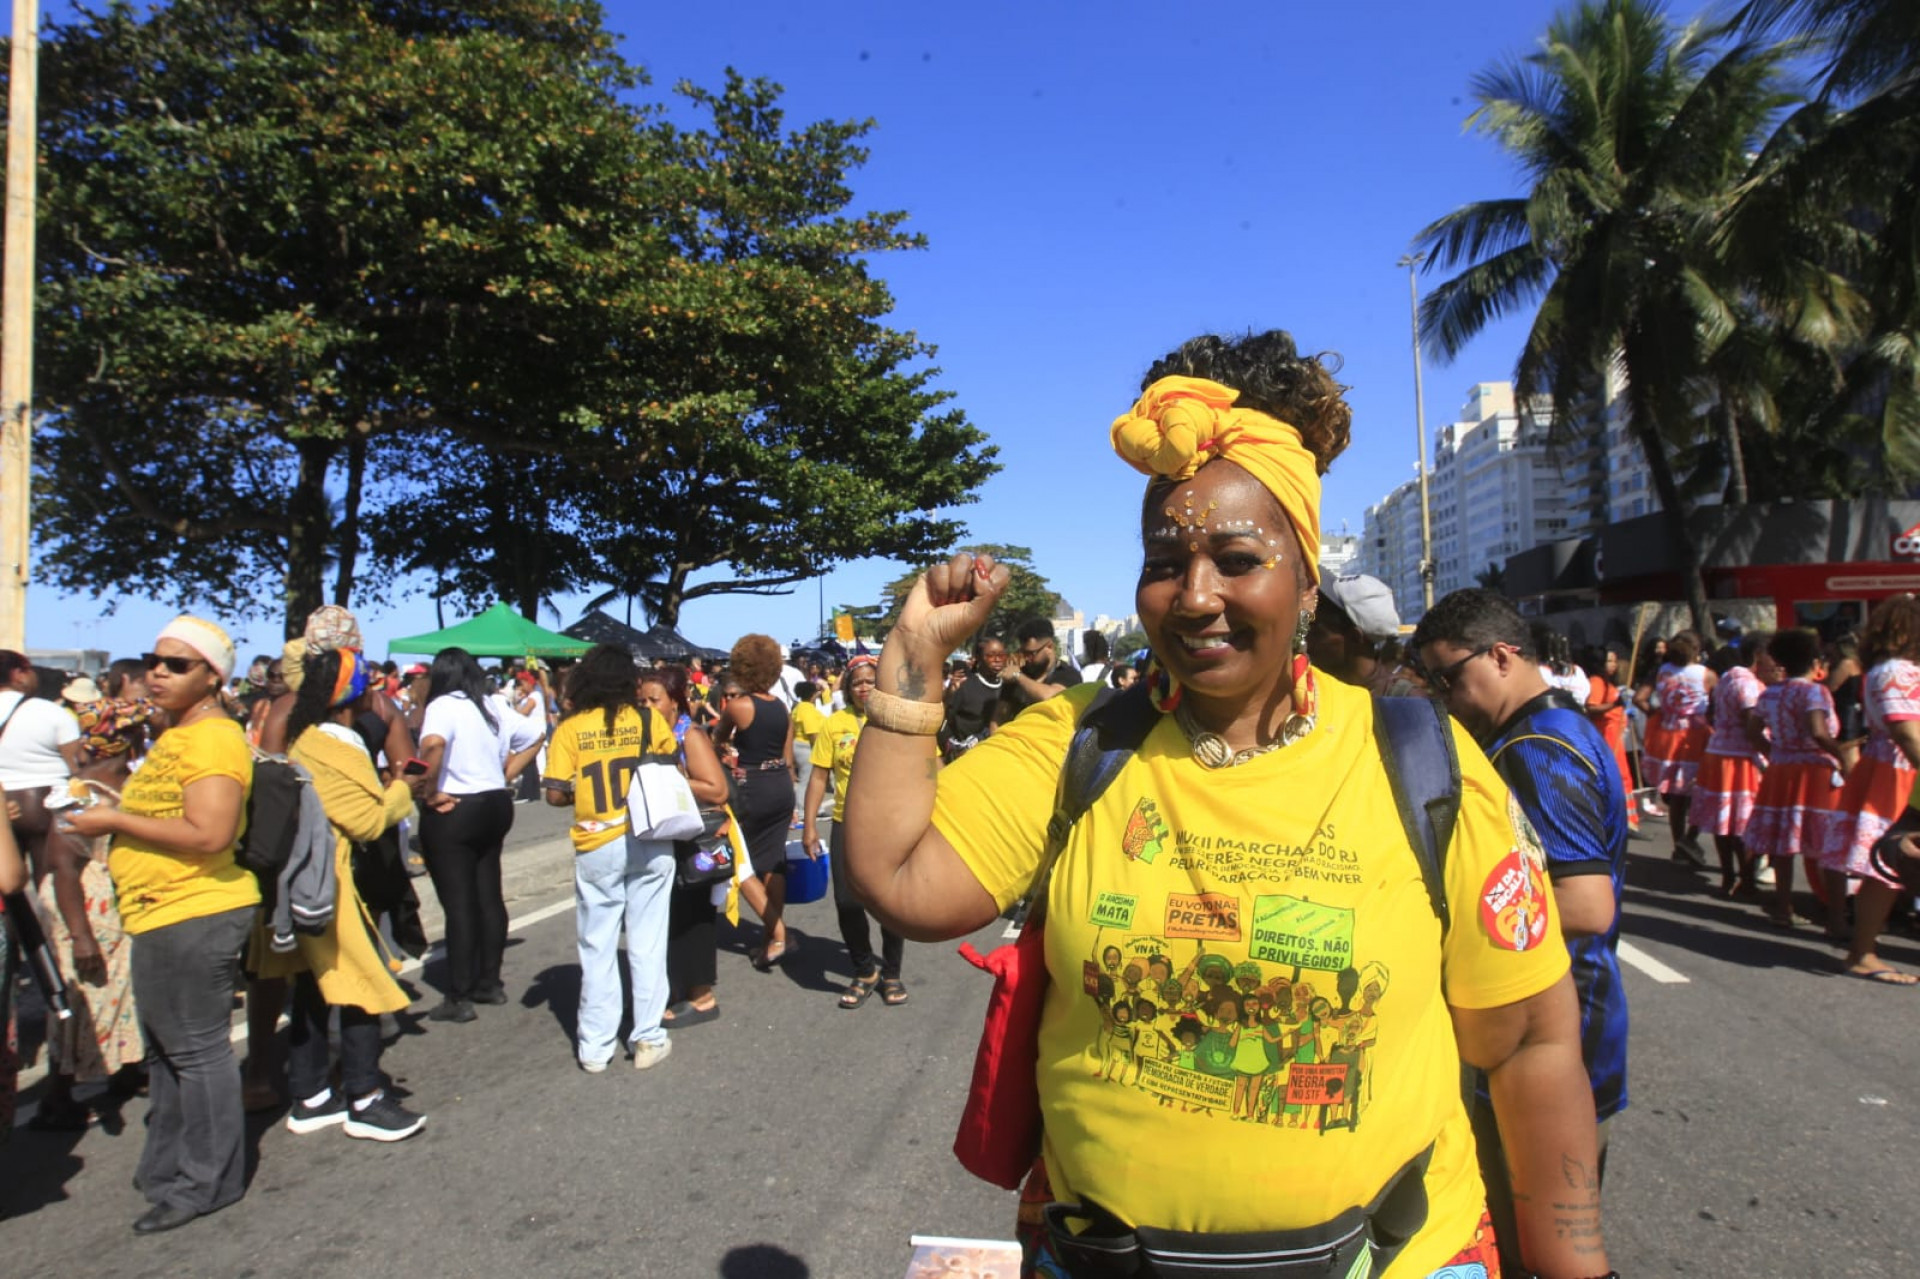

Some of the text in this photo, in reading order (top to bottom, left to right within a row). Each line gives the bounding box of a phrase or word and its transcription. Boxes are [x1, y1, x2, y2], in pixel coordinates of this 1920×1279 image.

[581, 756, 637, 814] 10
[1216, 837, 1304, 857] MARCHA
[1319, 841, 1335, 860] DO
[1339, 849, 1358, 863] RJ
[1295, 866, 1319, 881] BEM
[1501, 867, 1517, 886] DA
[1097, 904, 1129, 922] MATA
[1169, 898, 1183, 908] EU
[1186, 900, 1213, 912] VOTO
[1168, 909, 1237, 930] PRETAS
[1134, 944, 1160, 955] VIVAS
[1324, 936, 1350, 953] NÃO
[1258, 946, 1345, 969] PRIVILÉGIOS!
[1291, 1075, 1325, 1088] NEGRA
[1292, 1089, 1320, 1100] NO STF
